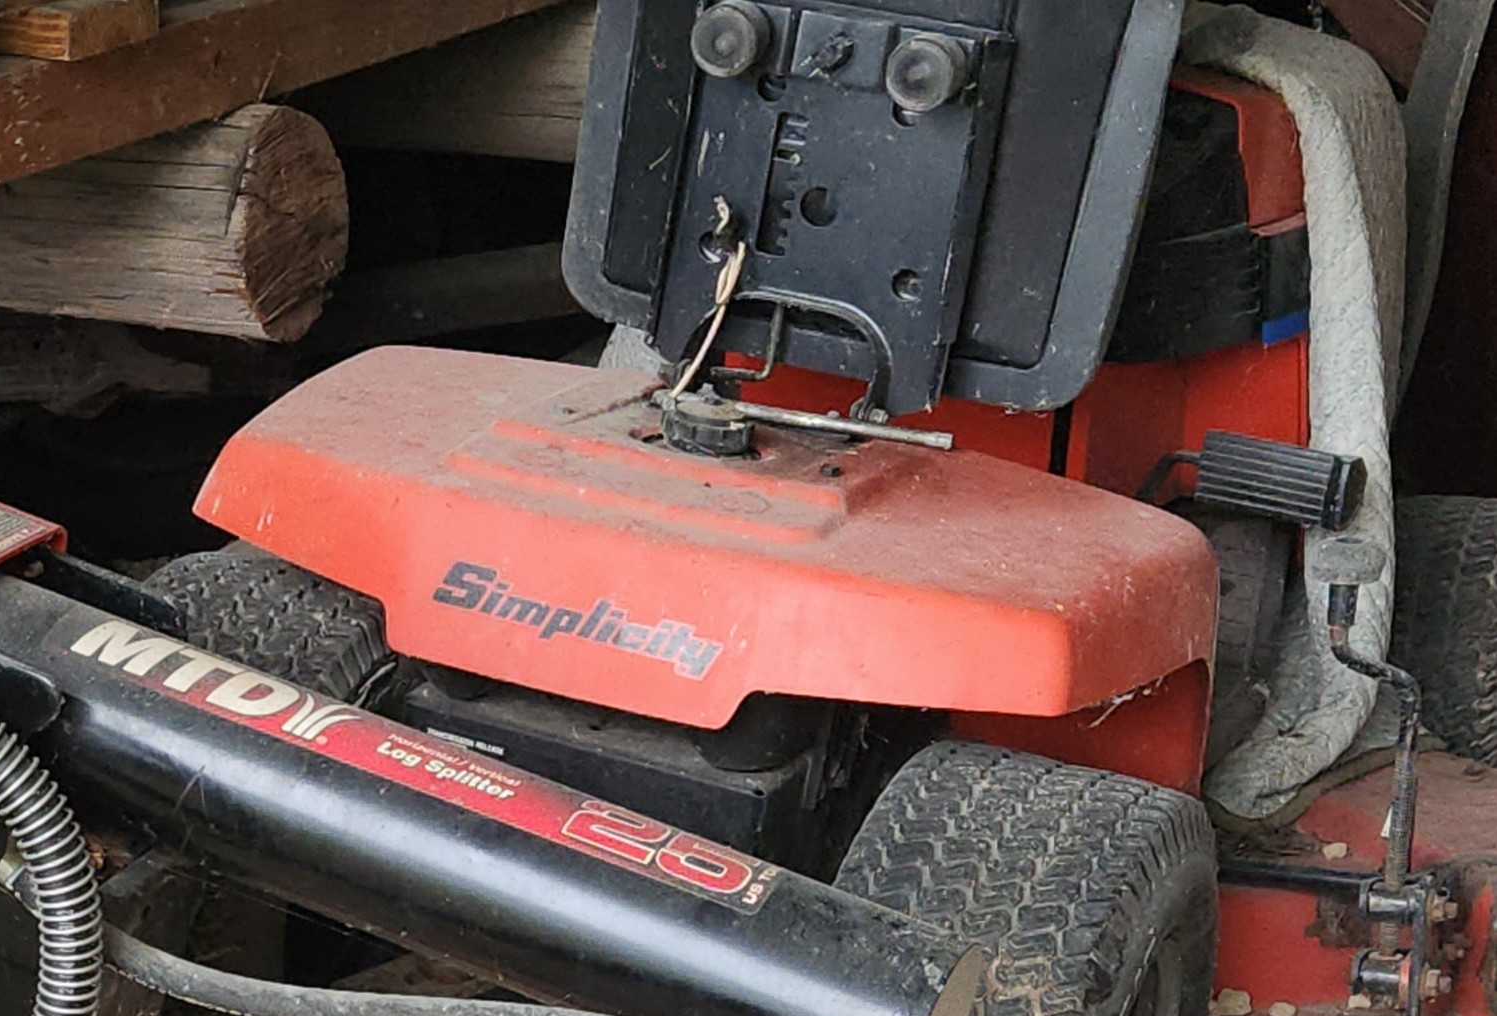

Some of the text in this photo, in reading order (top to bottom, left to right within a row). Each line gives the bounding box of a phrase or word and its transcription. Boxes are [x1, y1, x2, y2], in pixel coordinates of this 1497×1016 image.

[431, 559, 723, 679] Simplicity
[69, 619, 302, 717] MTD
[376, 741, 515, 799] Log Splitter
[742, 882, 764, 905] US
